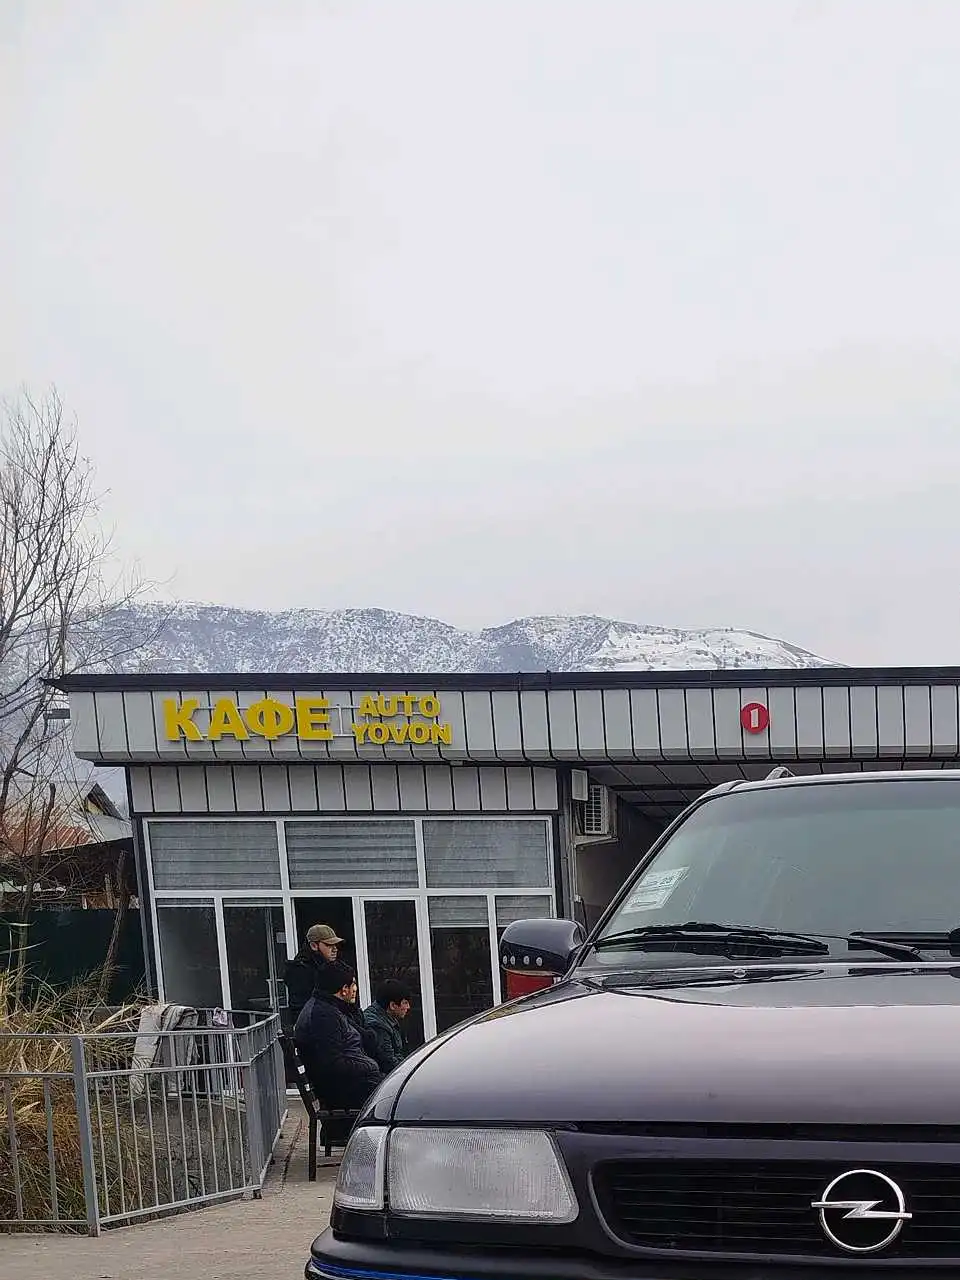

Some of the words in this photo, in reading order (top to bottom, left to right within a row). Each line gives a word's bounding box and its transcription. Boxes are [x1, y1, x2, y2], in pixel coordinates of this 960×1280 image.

[163, 695, 334, 741] КАФЕ
[359, 695, 441, 718] AUTO
[353, 722, 453, 745] YOVON
